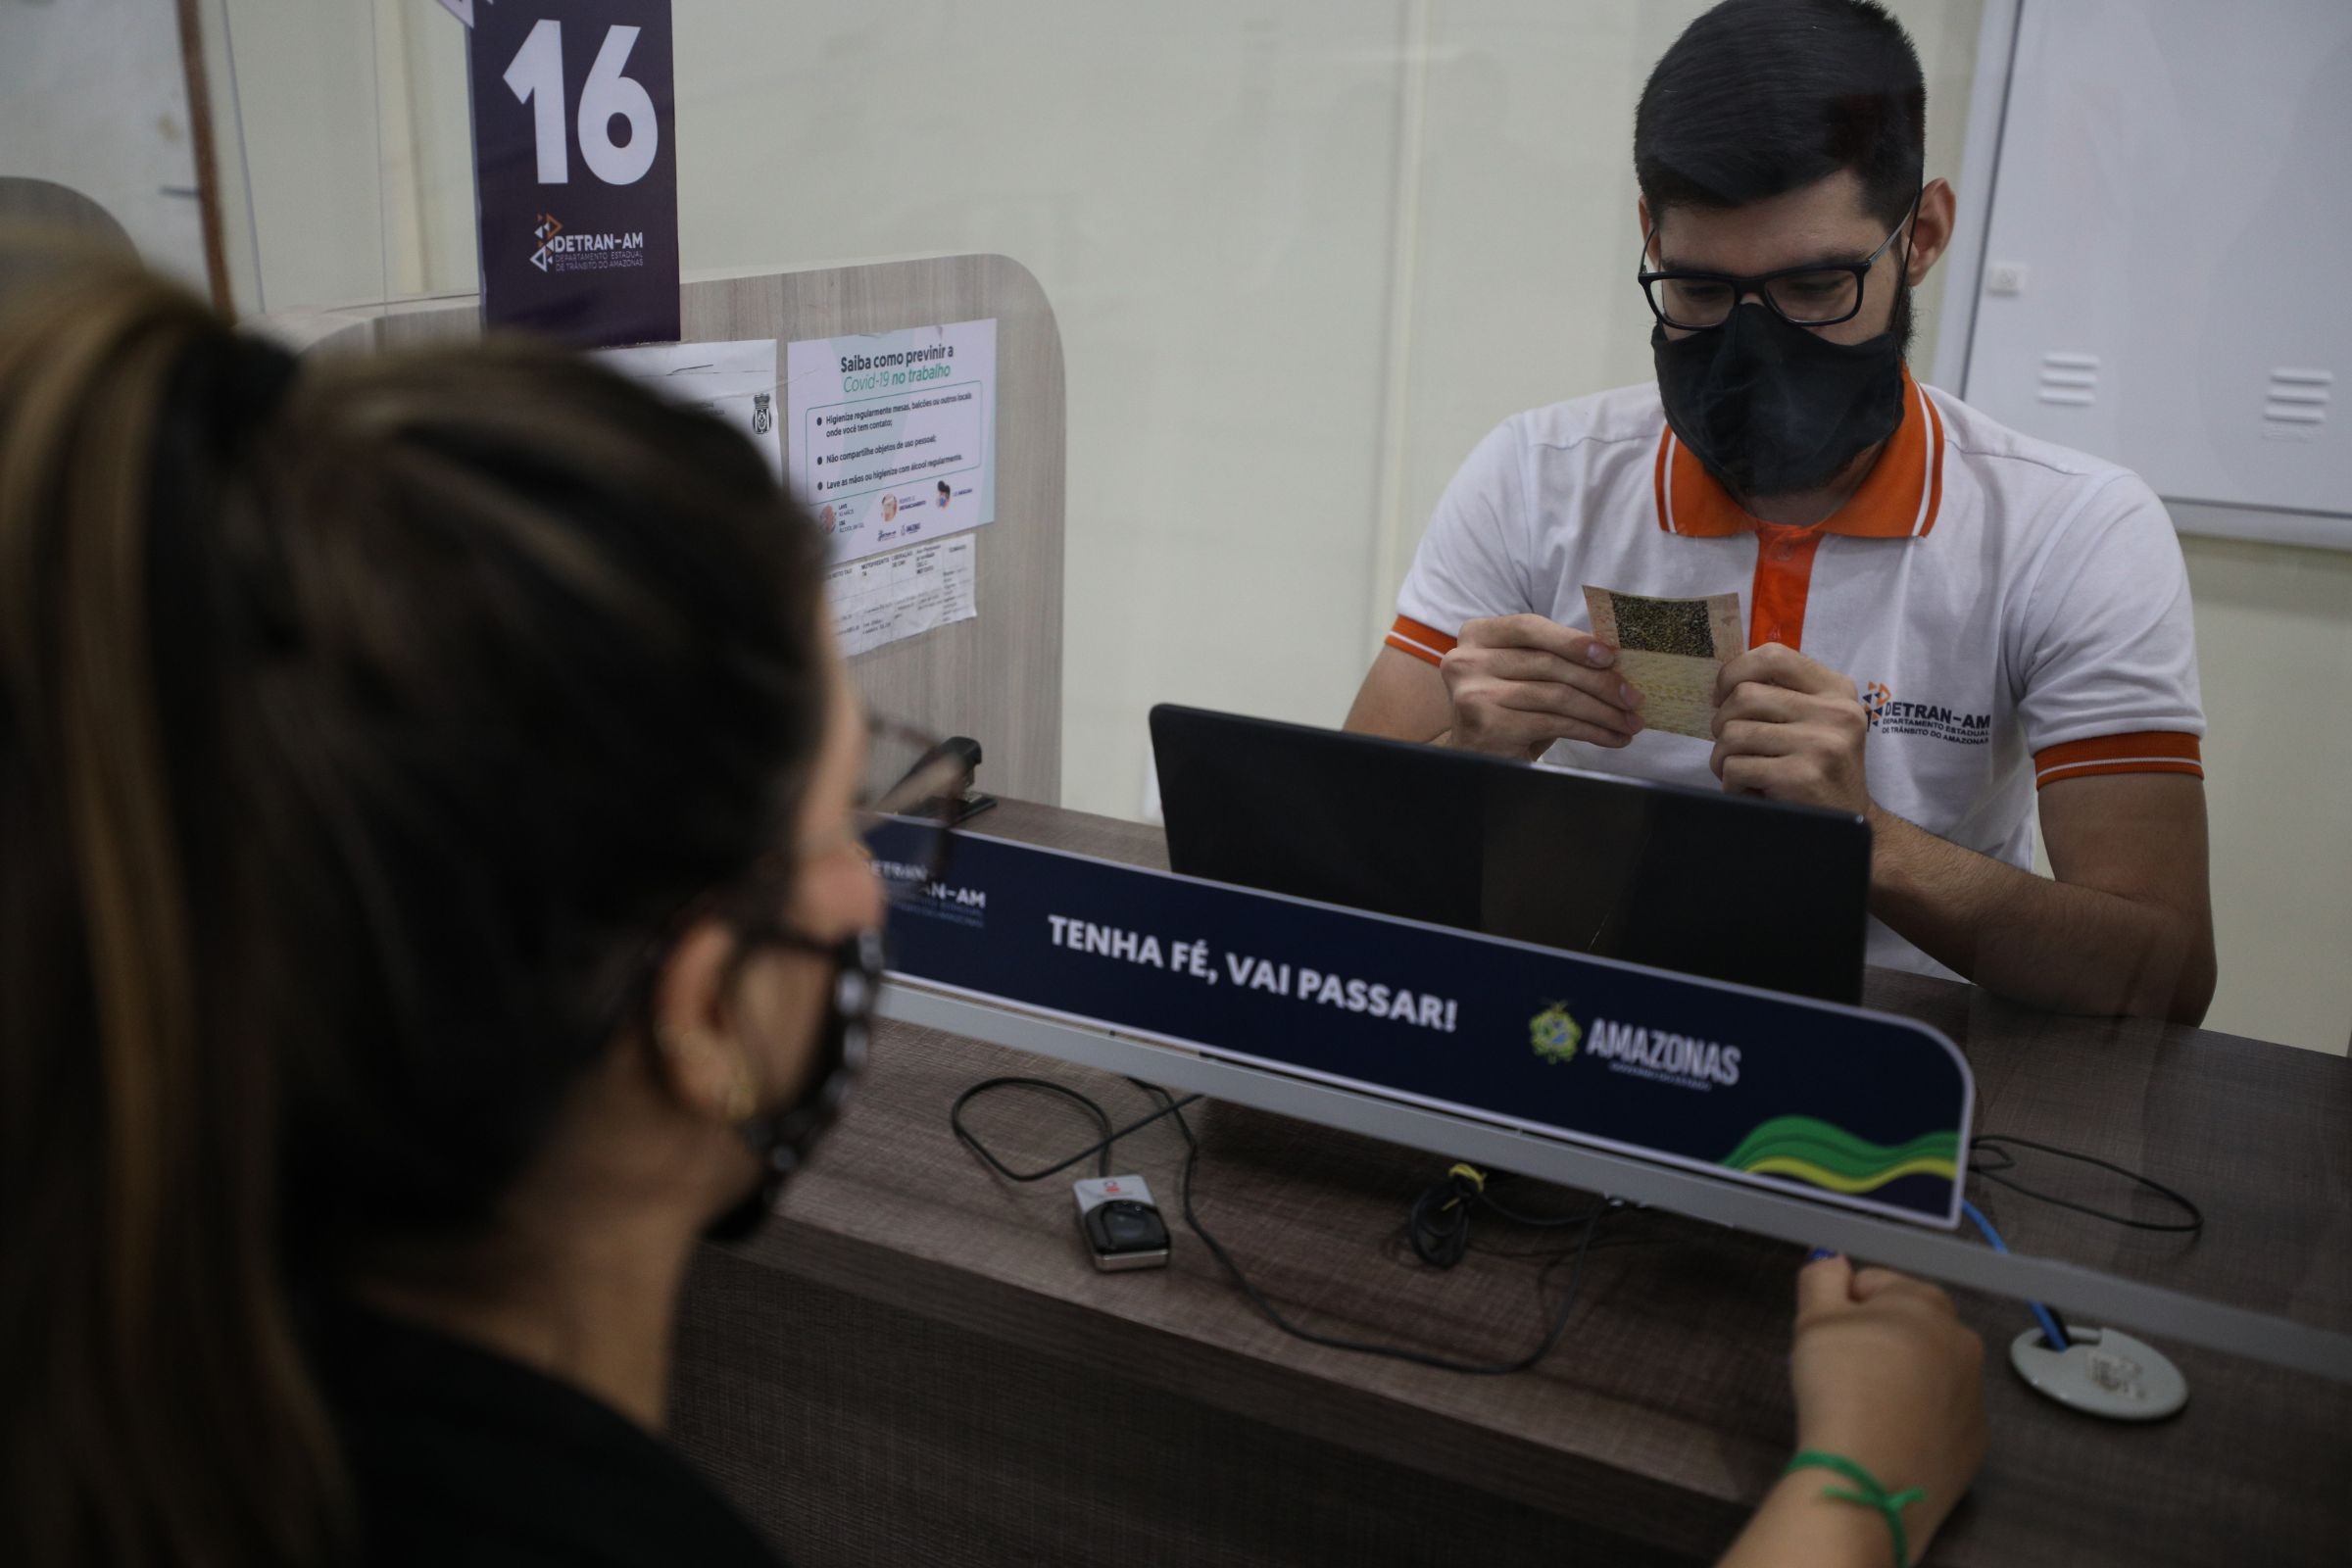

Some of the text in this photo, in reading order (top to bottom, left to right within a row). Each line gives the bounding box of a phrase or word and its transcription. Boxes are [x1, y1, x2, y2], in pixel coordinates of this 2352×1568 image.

[503, 19, 658, 185] 16
[554, 231, 644, 253] DETRAN-AM
[555, 250, 644, 263] DEPARTAMENTO ESTADUAL
[841, 344, 954, 373] Saiba como previnir a
[844, 363, 951, 393] Covid-19 no trabalho
[826, 413, 854, 425] Higienize
[855, 407, 892, 420] regularmente
[826, 427, 842, 438] onde
[843, 424, 857, 434] você
[858, 423, 869, 432] tem
[826, 454, 839, 464] Não
[840, 447, 874, 461] compartilhe
[875, 444, 896, 455] objetos
[897, 441, 904, 450] de
[905, 439, 913, 448] uso
[826, 480, 840, 490] Lave
[849, 474, 864, 485] mãos
[873, 467, 898, 480] higienize
[899, 465, 910, 473] com
[1883, 718, 1989, 736] DEPARTAMENTO ESTADUAL
[1885, 702, 1991, 729] DETRAN-AM
[1891, 725, 1929, 736] TRÂNSITO
[1942, 735, 1989, 746] AMAZONAS
[1048, 914, 1458, 1033] TENHA FÉ, VAI PASSAR!
[1585, 1017, 1742, 1086] AMAZONAS
